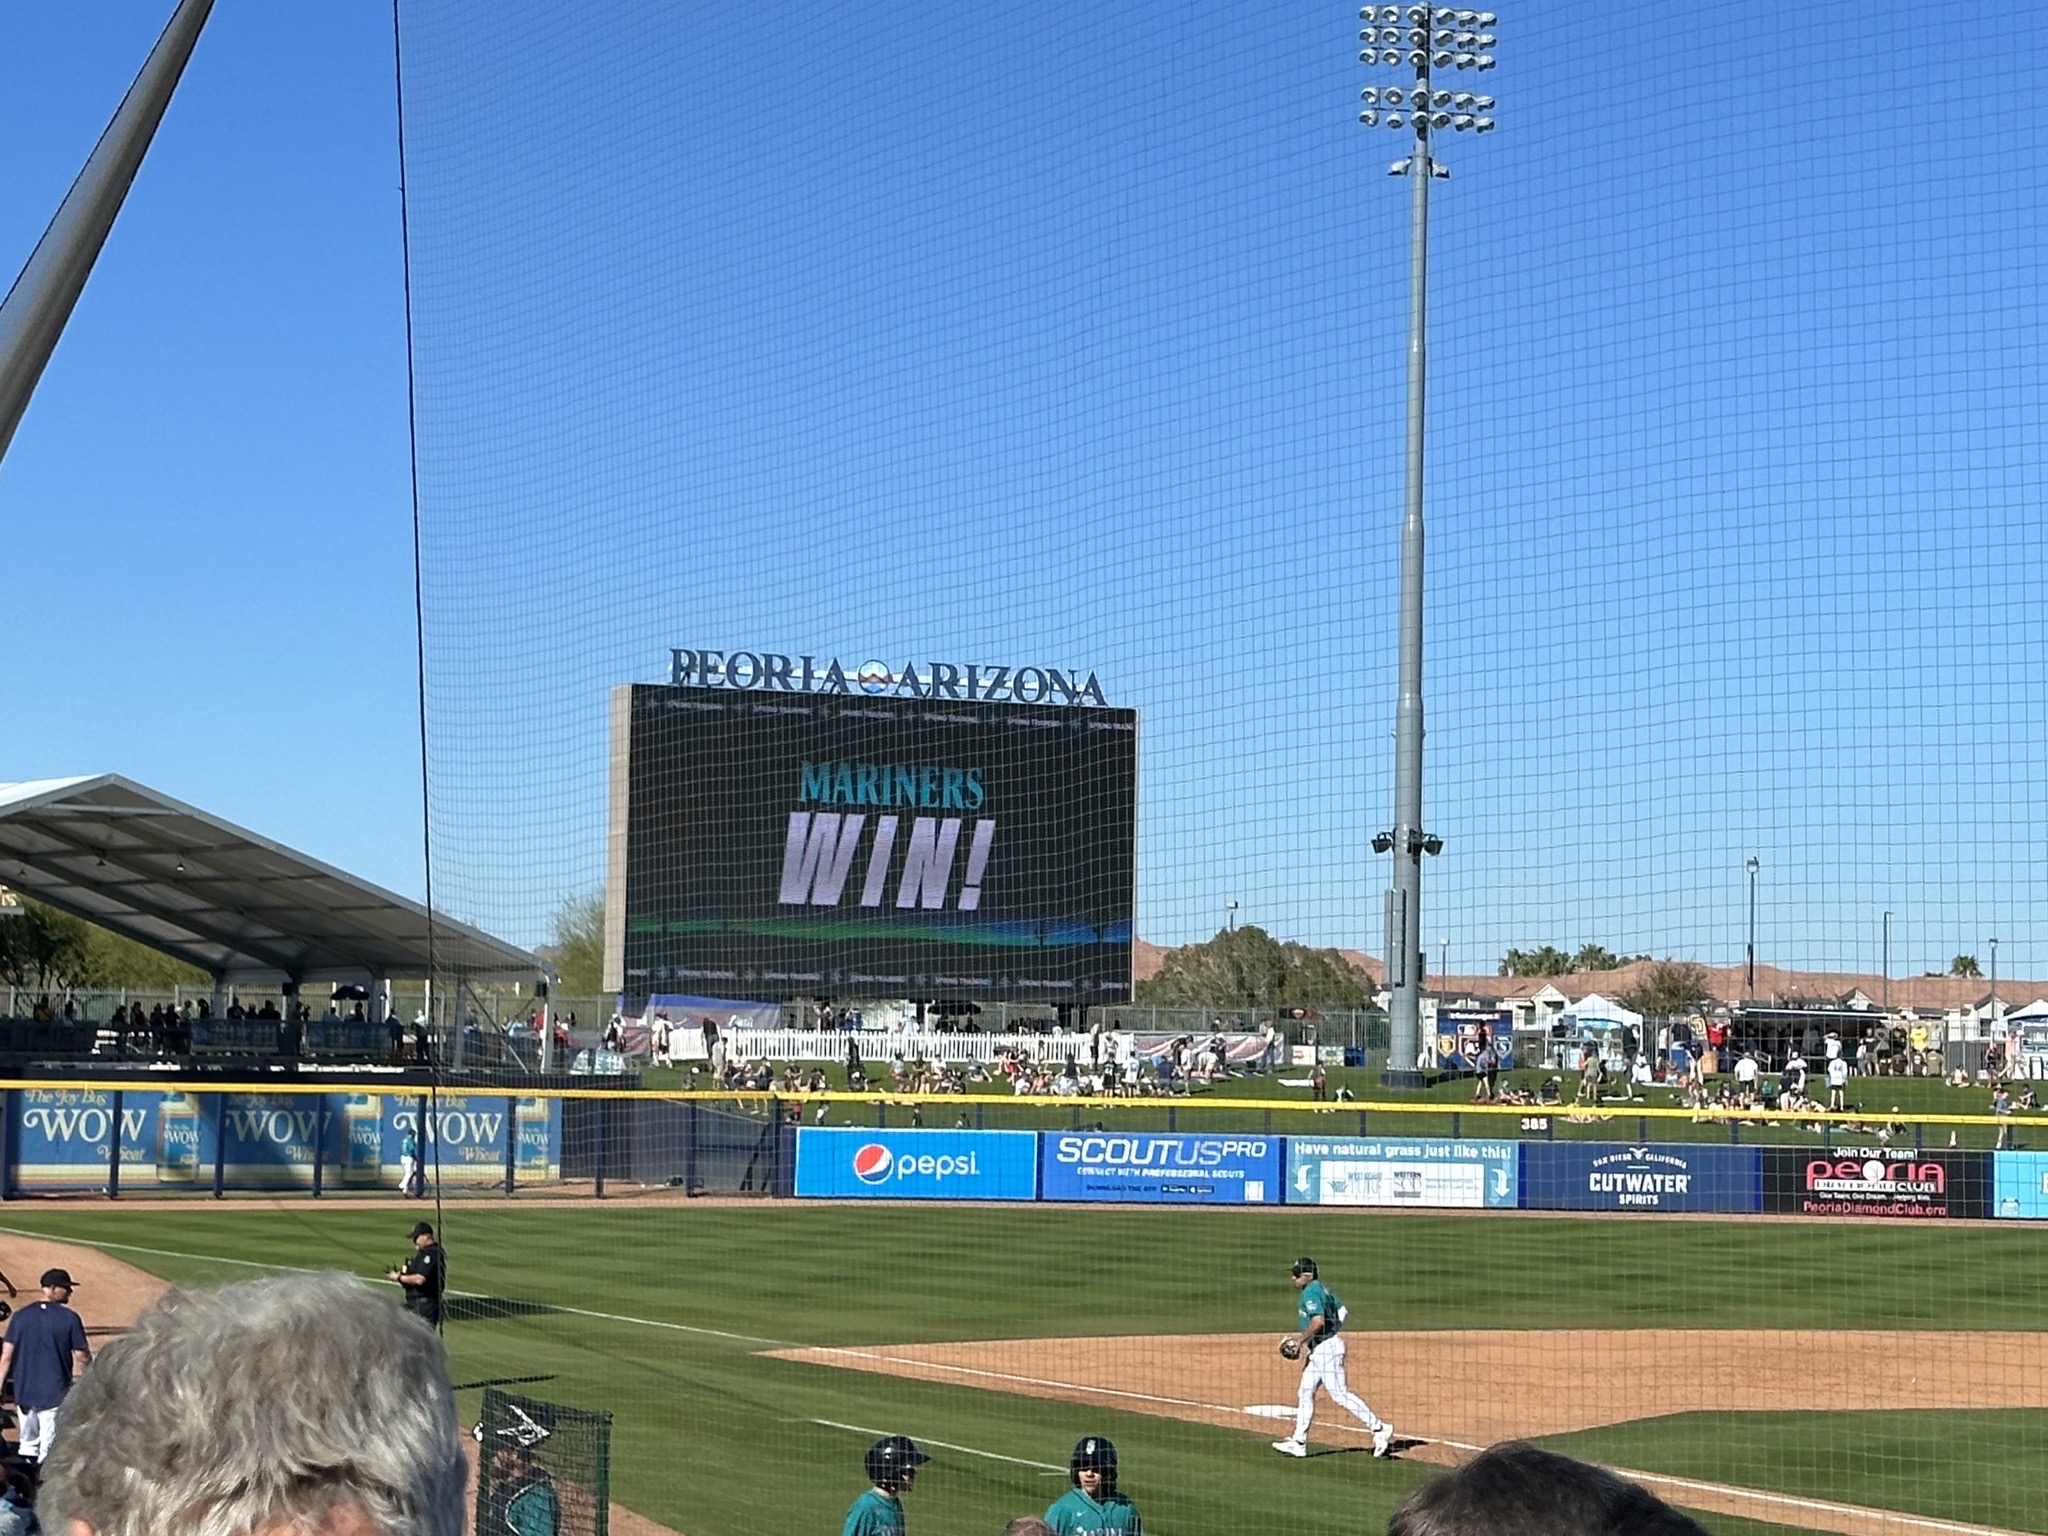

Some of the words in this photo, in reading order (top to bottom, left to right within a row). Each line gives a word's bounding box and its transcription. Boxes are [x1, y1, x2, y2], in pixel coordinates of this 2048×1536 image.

[669, 648, 850, 694] PEORIA
[892, 660, 1108, 706] ARIZONA
[799, 761, 983, 809] MARINERS
[778, 811, 996, 910] WIN!
[25, 1090, 54, 1103] The
[55, 1090, 77, 1106] Joy
[82, 1090, 107, 1105] Bus
[23, 1109, 147, 1142] WOW
[226, 1110, 332, 1143] WOW
[393, 1112, 502, 1144] WOW
[898, 1150, 977, 1180] pepsi
[1295, 1142, 1329, 1156] Have
[1333, 1143, 1381, 1156] natural
[1385, 1145, 1421, 1158] grass
[1424, 1144, 1450, 1158] just
[1454, 1144, 1478, 1158] like
[1481, 1146, 1511, 1159] this!
[1833, 1148, 1858, 1158] Join
[1860, 1148, 1880, 1158] Our
[1883, 1148, 1918, 1159] Team!
[1589, 1173, 1688, 1193] CUTWATER
[1619, 1194, 1658, 1205] SPIRITS
